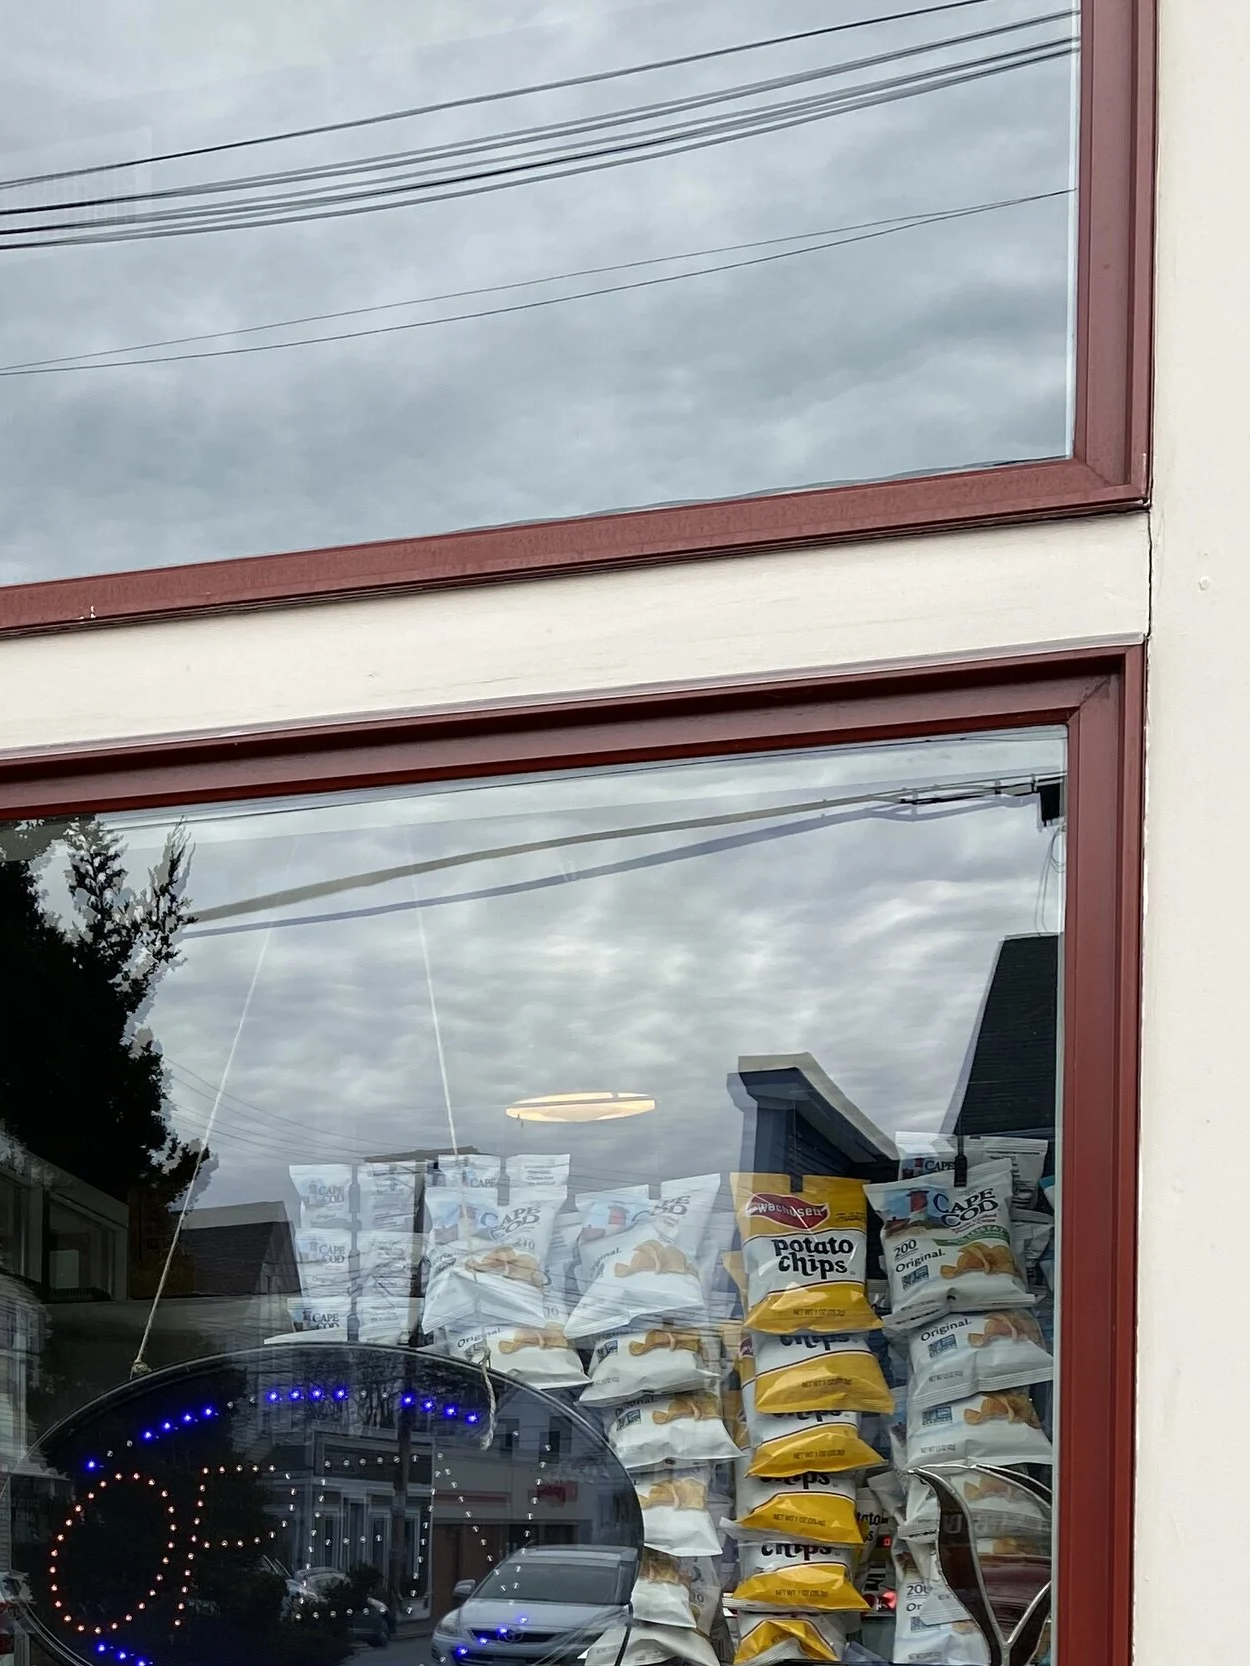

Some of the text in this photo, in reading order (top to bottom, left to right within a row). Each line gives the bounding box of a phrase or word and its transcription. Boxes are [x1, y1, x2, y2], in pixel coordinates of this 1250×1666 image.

[932, 1188, 997, 1214] CAPE
[940, 1199, 1000, 1228] COD
[771, 1236, 854, 1257] potato
[777, 1250, 849, 1280] chips
[49, 1445, 553, 1634] OPEN
